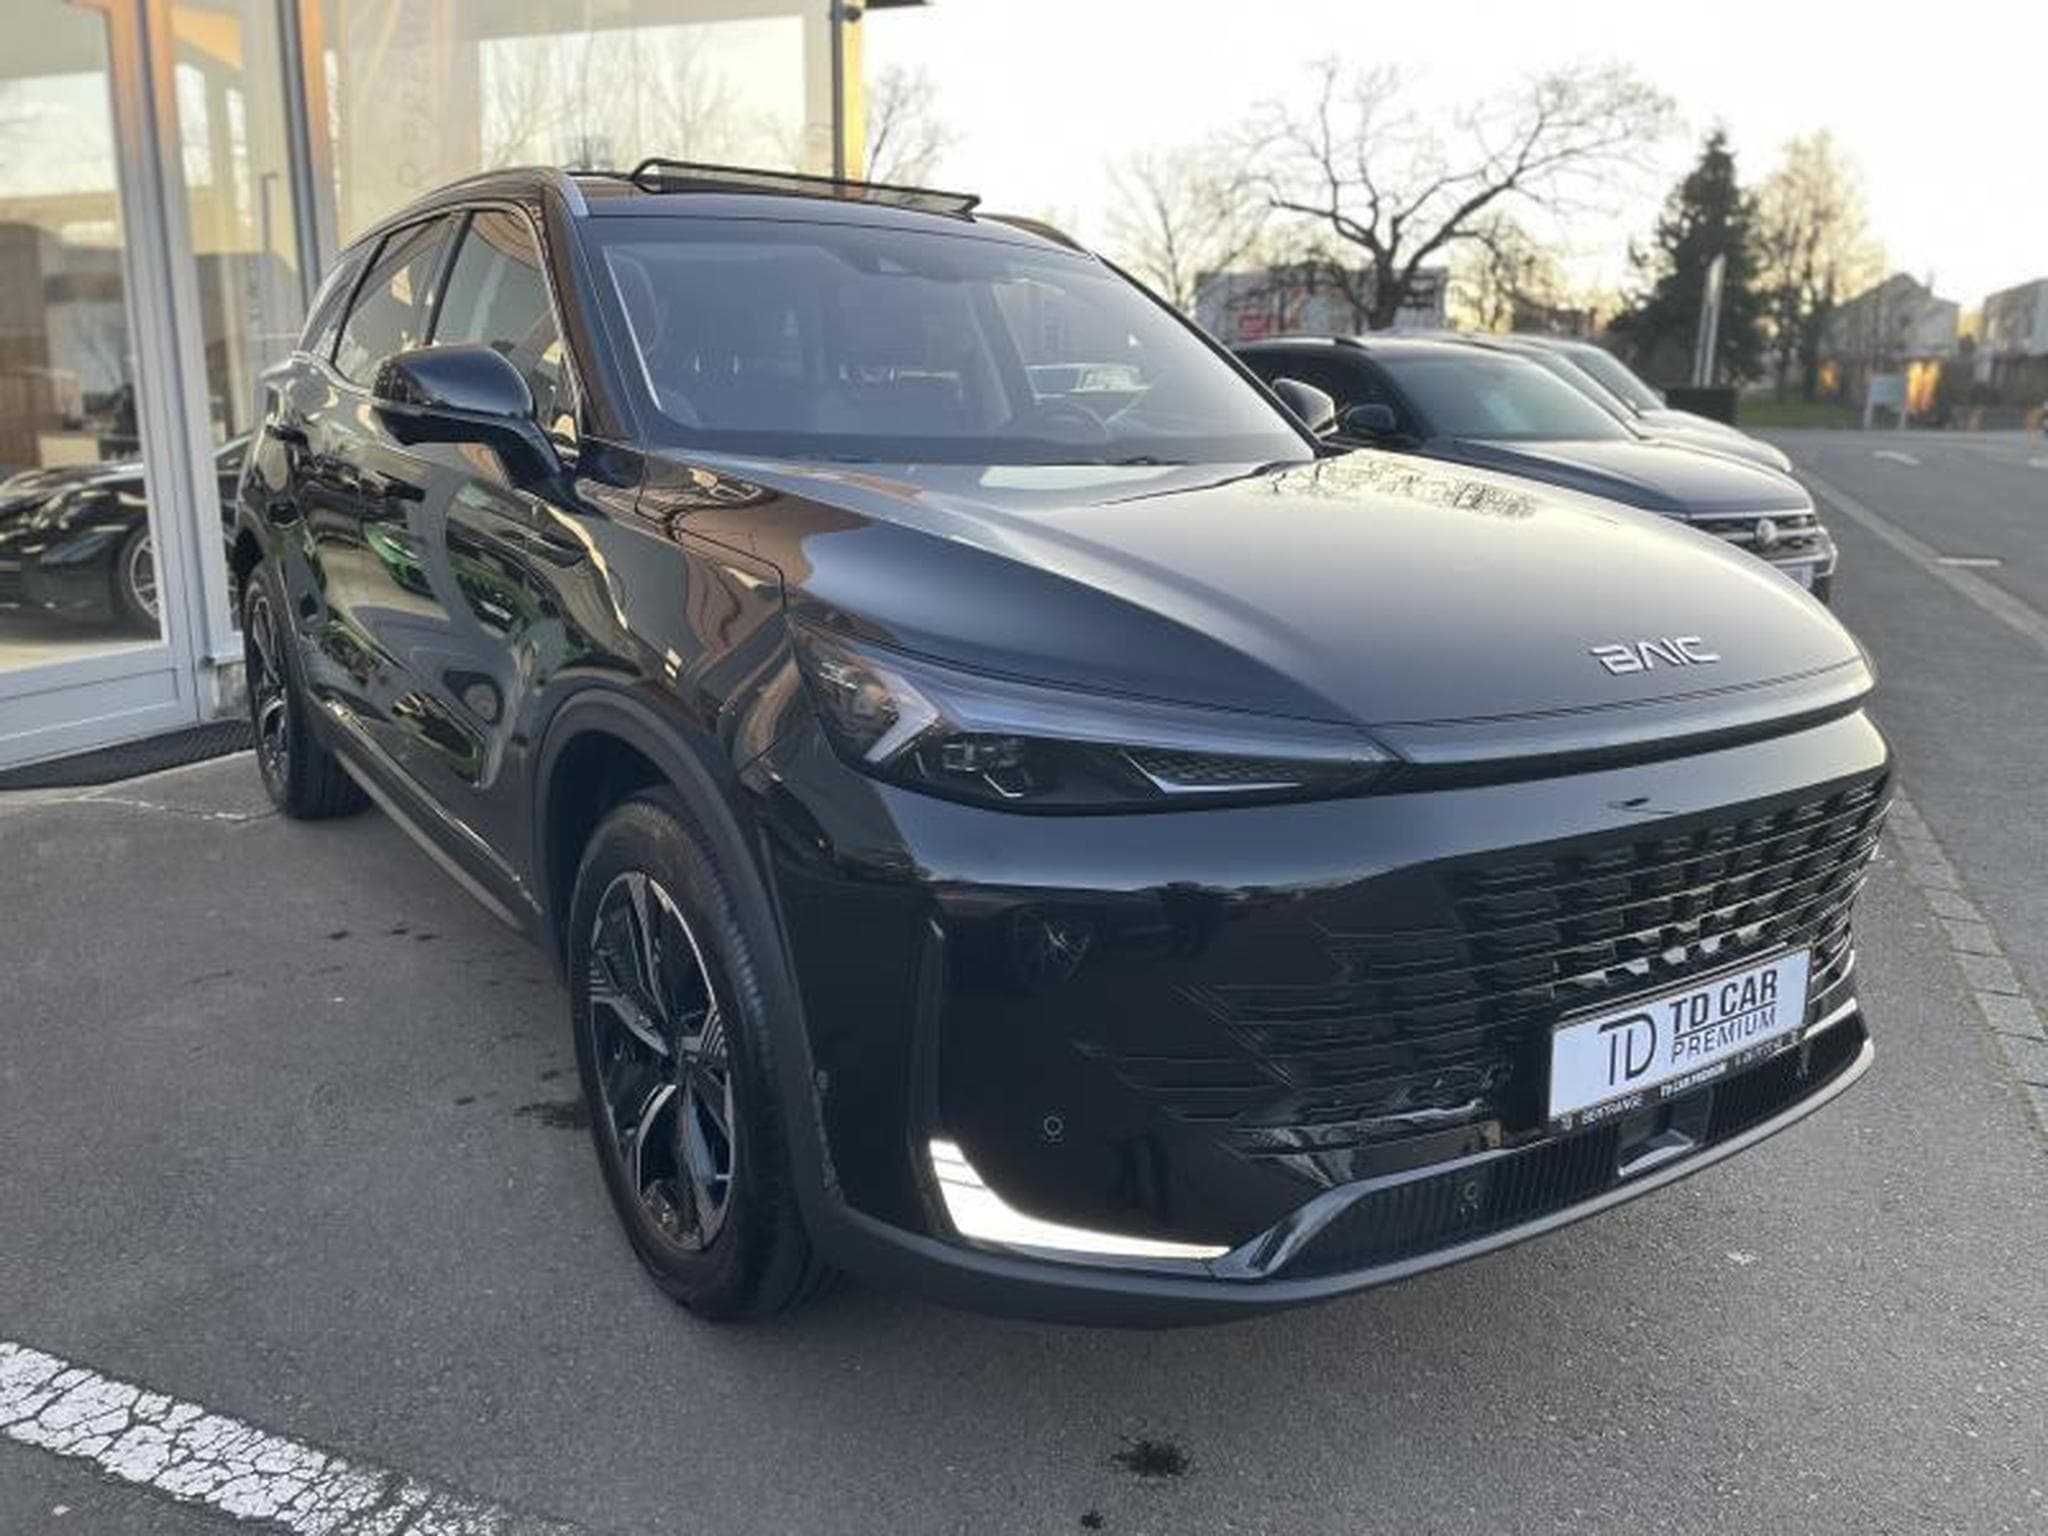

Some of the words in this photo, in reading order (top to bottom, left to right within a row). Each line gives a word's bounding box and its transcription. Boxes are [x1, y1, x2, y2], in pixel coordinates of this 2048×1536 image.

[1590, 635, 1720, 675] BAIC
[1669, 993, 1709, 1035] TD
[1720, 969, 1778, 1017] CAR
[1671, 1007, 1776, 1063] PREMIUM
